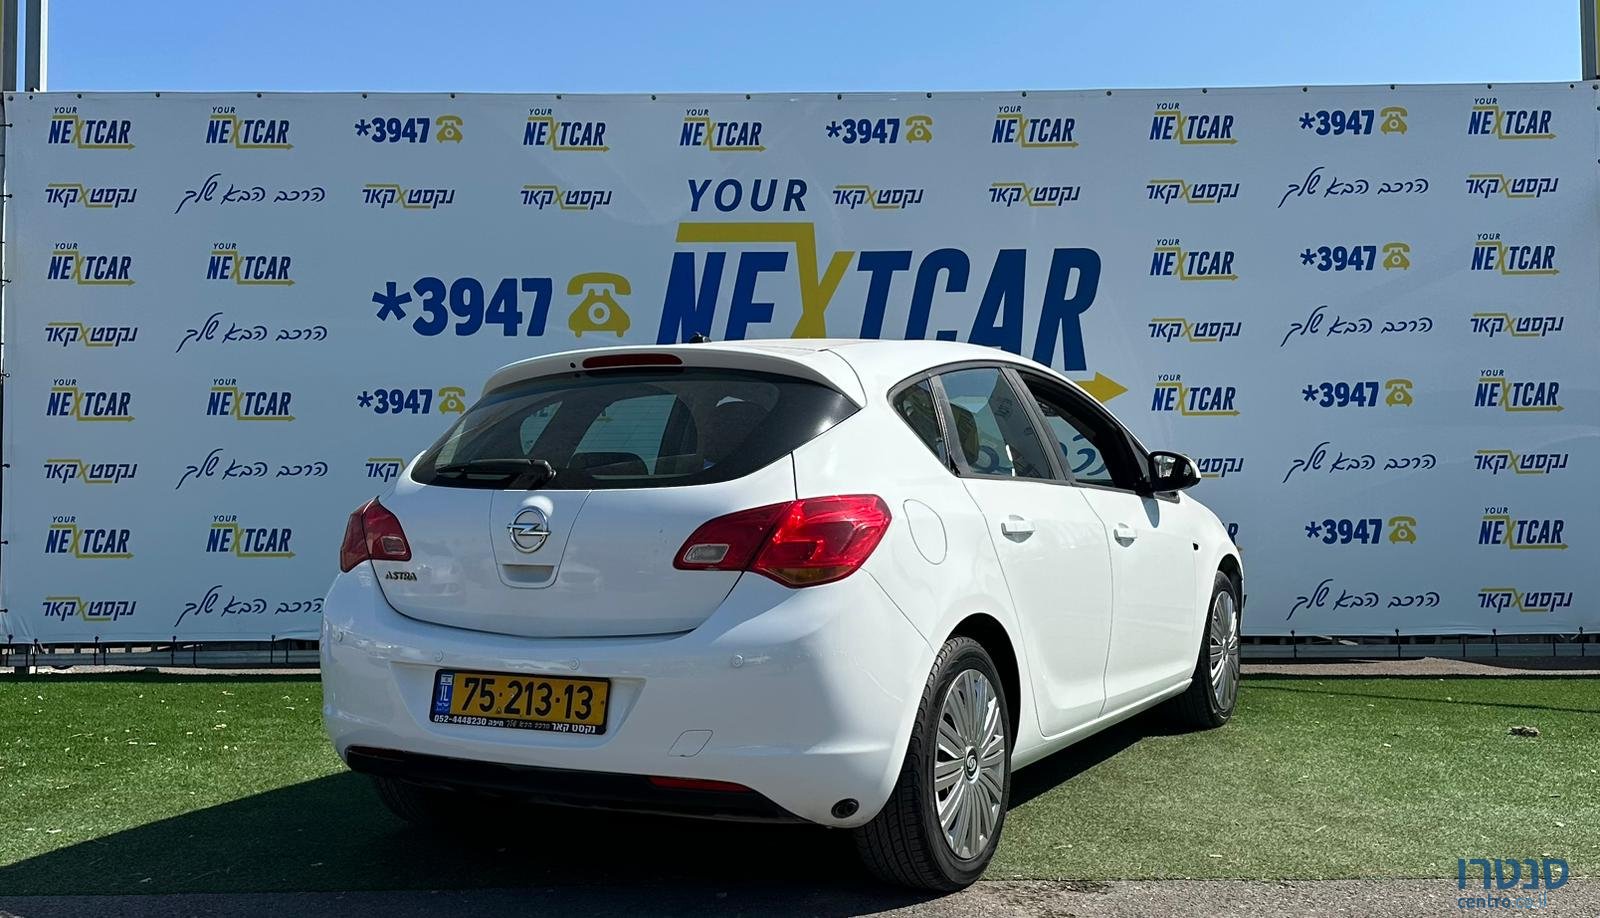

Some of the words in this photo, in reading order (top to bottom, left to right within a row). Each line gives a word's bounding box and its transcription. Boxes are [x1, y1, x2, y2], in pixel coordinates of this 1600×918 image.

[54, 106, 78, 114] YOUR
[212, 106, 236, 114] YOUR
[529, 108, 553, 116] YOUR
[998, 105, 1022, 113] YOUR
[1156, 102, 1180, 110] YOUR
[1474, 97, 1498, 105] YOUR
[686, 108, 709, 117] YOUR
[1467, 111, 1551, 134] NEXTCAR
[47, 120, 131, 143] NEXTCAR
[205, 120, 289, 143] NEXTCAR
[522, 122, 605, 145] NEXTCAR
[679, 122, 762, 146] NEXTCAR
[991, 118, 1075, 143] NEXTCAR
[1149, 115, 1233, 140] NEXTCAR
[175, 173, 222, 214] שלך
[221, 184, 266, 206] הבא
[274, 187, 325, 203] הרכב
[688, 179, 807, 212] YOUR
[1278, 167, 1325, 208] שלך
[1324, 177, 1370, 198] הבא
[1377, 179, 1428, 195] הרכב
[55, 242, 78, 250] YOUR
[213, 242, 237, 250] YOUR
[1156, 238, 1180, 246] YOUR
[1477, 232, 1501, 241] YOUR
[47, 256, 131, 279] NEXTCAR
[206, 256, 291, 279] NEXTCAR
[1149, 251, 1234, 275] NEXTCAR
[1470, 246, 1555, 270] NEXTCAR
[176, 312, 224, 353] שלך
[222, 323, 268, 344] הבא
[276, 326, 327, 342] הרכב
[1281, 306, 1328, 347] שלך
[1327, 316, 1373, 337] הבא
[1381, 317, 1432, 335] הרכב
[53, 378, 77, 386] YOUR
[213, 378, 237, 386] YOUR
[1157, 374, 1181, 382] YOUR
[1480, 369, 1505, 377] YOUR
[46, 392, 131, 416] NEXTCAR
[206, 392, 291, 415] NEXTCAR
[1151, 387, 1235, 411] NEXTCAR
[1474, 382, 1559, 406] NEXTCAR
[176, 449, 224, 489] שלך
[222, 459, 269, 481] הבא
[276, 462, 328, 478] הרכב
[1283, 442, 1331, 483] שלך
[1329, 452, 1376, 474] הבא
[1384, 454, 1436, 471] הרכב
[52, 515, 76, 524] YOUR
[213, 514, 238, 523] YOUR
[1484, 506, 1509, 515] YOUR
[44, 529, 130, 553] NEXTCAR
[205, 528, 291, 552] NEXTCAR
[1478, 520, 1564, 544] NEXTCAR
[385, 571, 417, 582] ASTRA
[174, 585, 223, 627] שלך
[221, 596, 268, 618] הבא
[1286, 579, 1334, 621] שלך
[1333, 589, 1380, 612] הבא
[1387, 592, 1440, 609] הרכב
